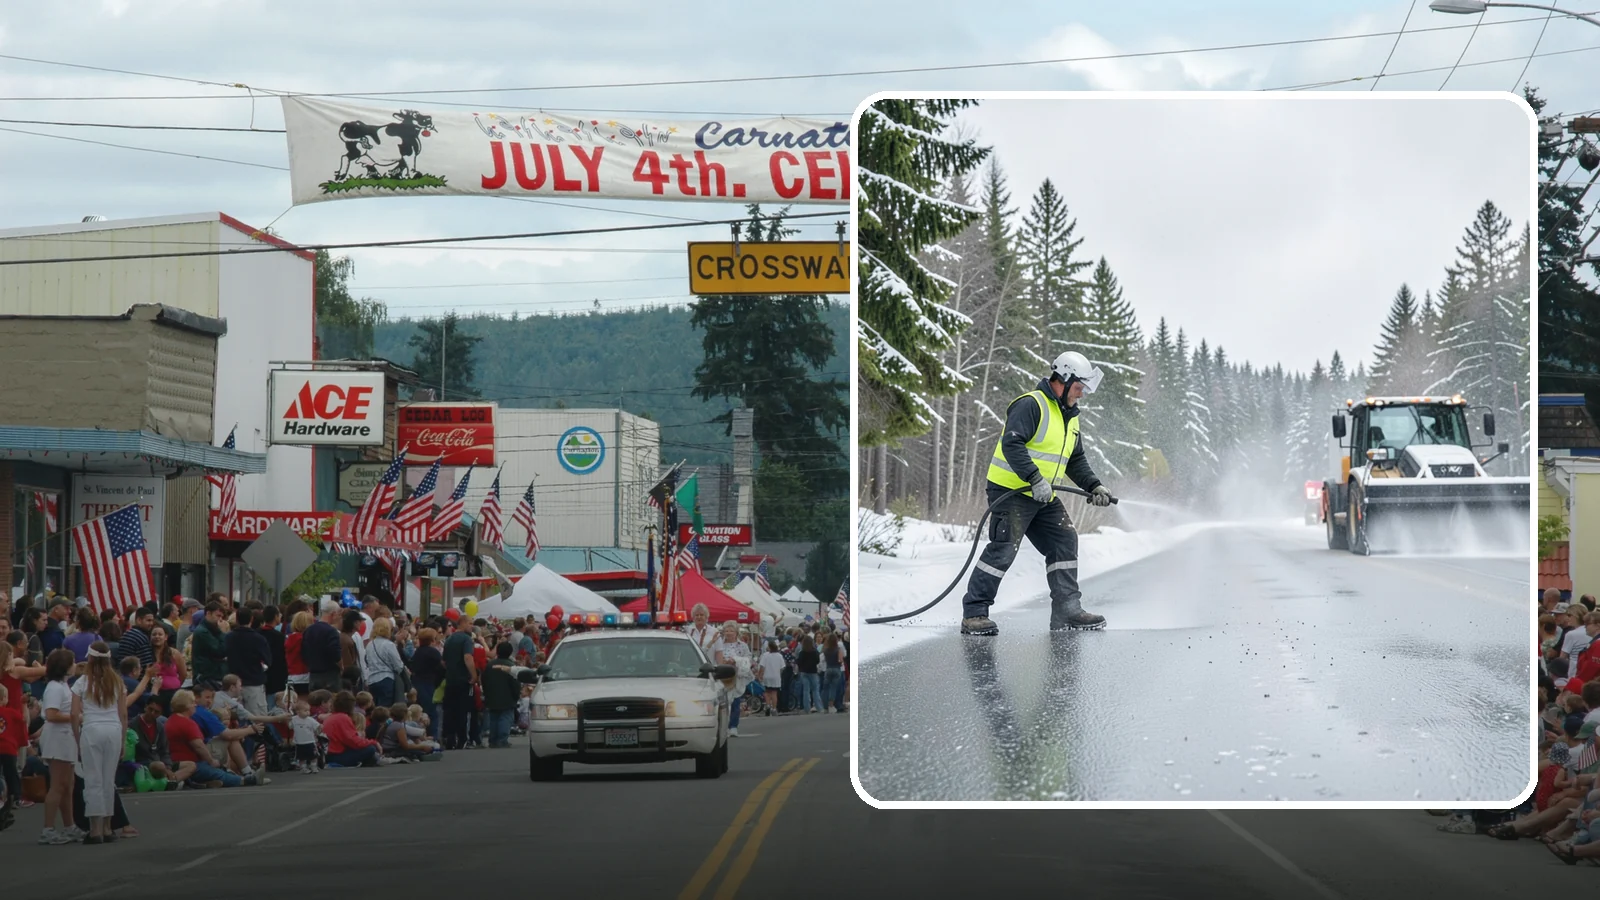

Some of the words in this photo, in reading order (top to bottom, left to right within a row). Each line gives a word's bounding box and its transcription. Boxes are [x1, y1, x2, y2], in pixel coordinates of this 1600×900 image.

[481, 141, 604, 192] JULY
[632, 150, 746, 198] 4th.
[697, 254, 850, 280] CROSSWA
[282, 379, 374, 420] ACE
[406, 409, 452, 421] CEDAR
[461, 409, 485, 421] LOG
[283, 421, 371, 437] Hardware
[96, 485, 124, 494] Vincent
[126, 486, 136, 494] de
[138, 486, 155, 495] Paul
[212, 516, 331, 535] HARDARE
[688, 526, 742, 535] CRNATION
[699, 535, 730, 543] GLASS
